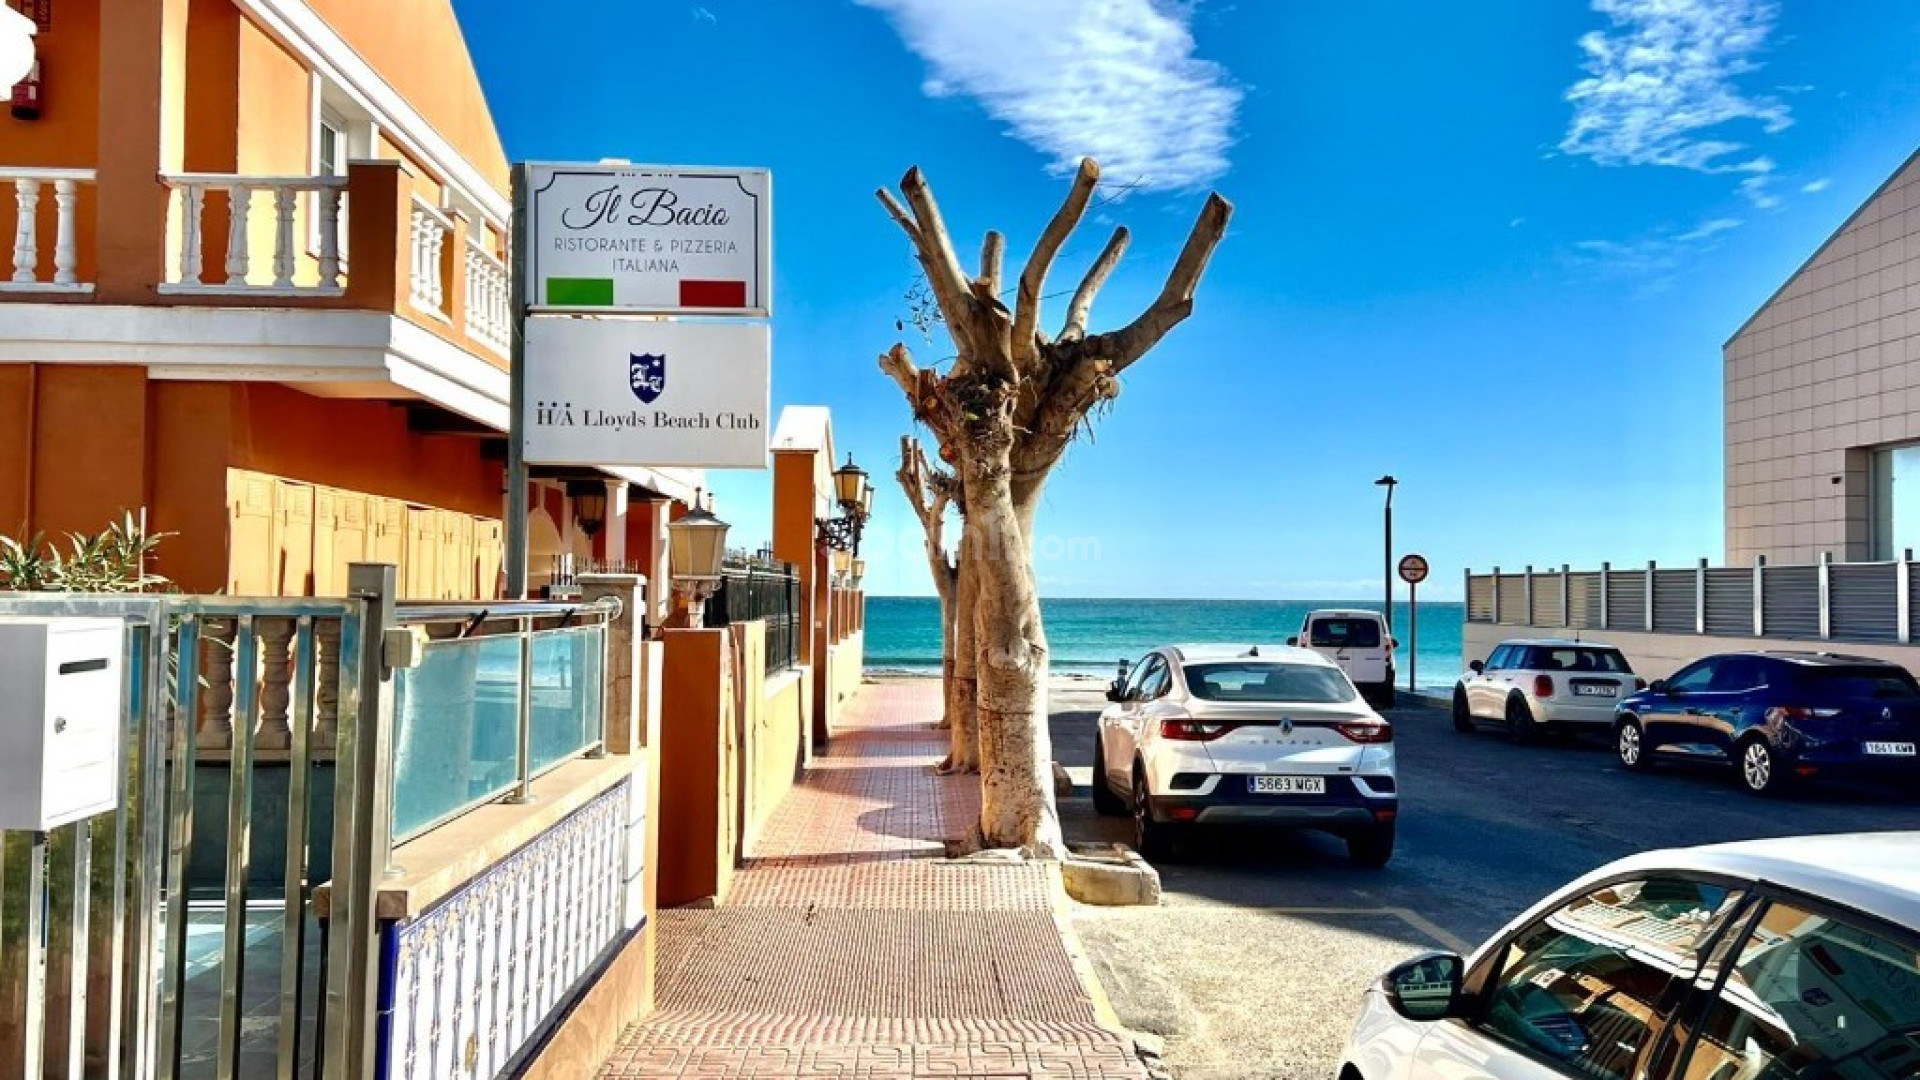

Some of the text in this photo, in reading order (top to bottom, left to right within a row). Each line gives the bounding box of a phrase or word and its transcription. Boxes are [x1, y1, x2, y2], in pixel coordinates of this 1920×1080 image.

[562, 184, 730, 230] Il Bacio
[554, 237, 738, 255] RISTORANTE & PIZZERIA
[612, 258, 680, 273] ITALIANA
[583, 409, 646, 432] Lloyds
[652, 410, 711, 429] Beach
[715, 411, 760, 430] Club
